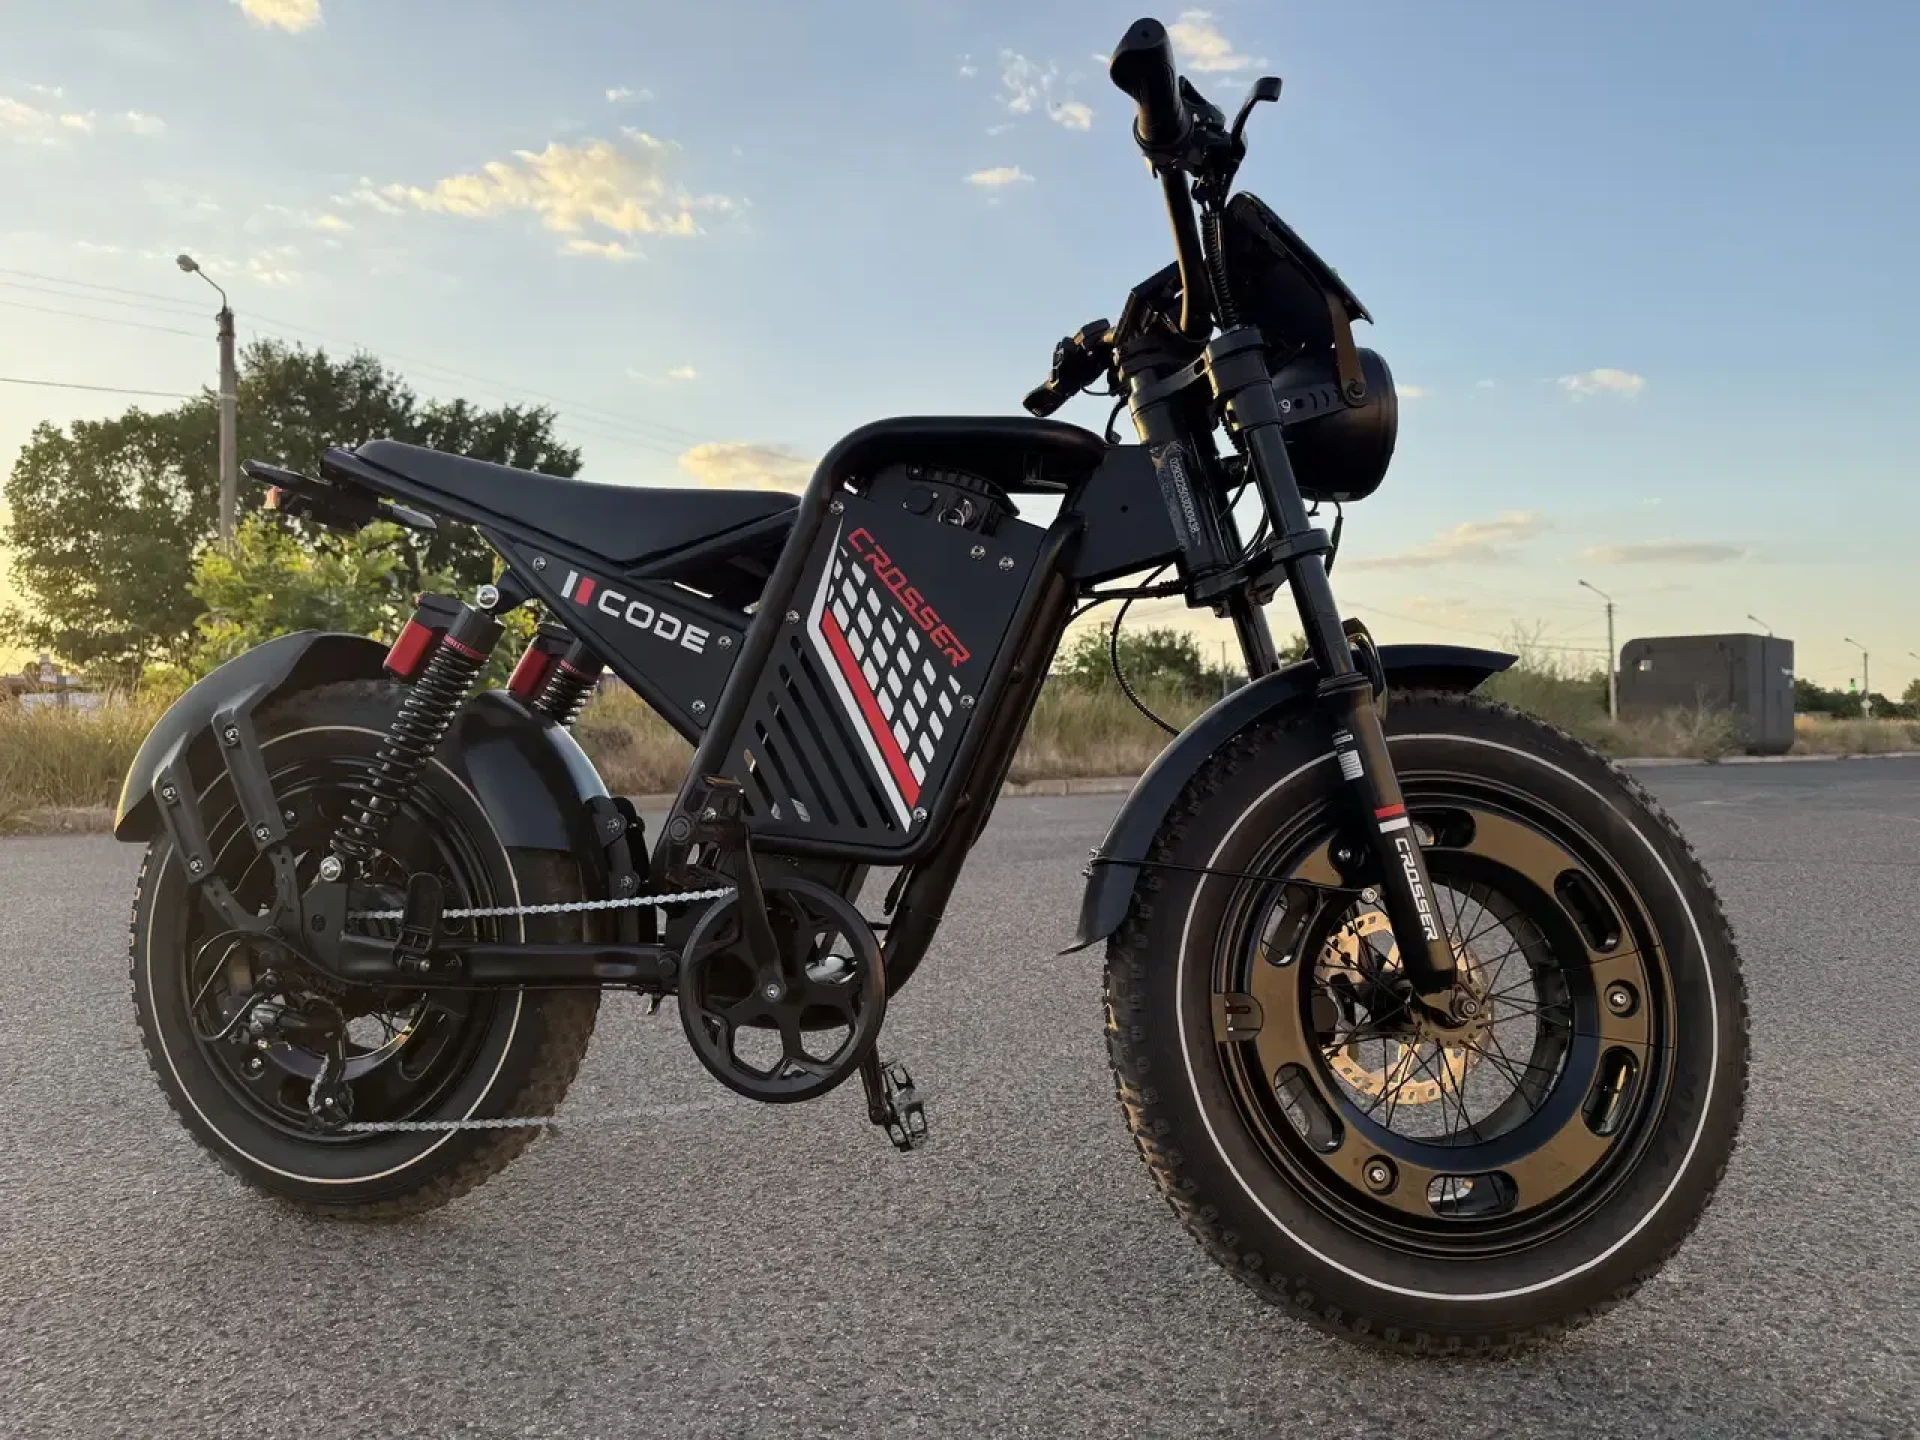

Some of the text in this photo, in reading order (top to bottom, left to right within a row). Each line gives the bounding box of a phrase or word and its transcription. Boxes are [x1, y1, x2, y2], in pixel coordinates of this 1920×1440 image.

[597, 589, 710, 654] CODE
[847, 527, 972, 667] CROSSER
[1394, 837, 1439, 941] CROSSER
